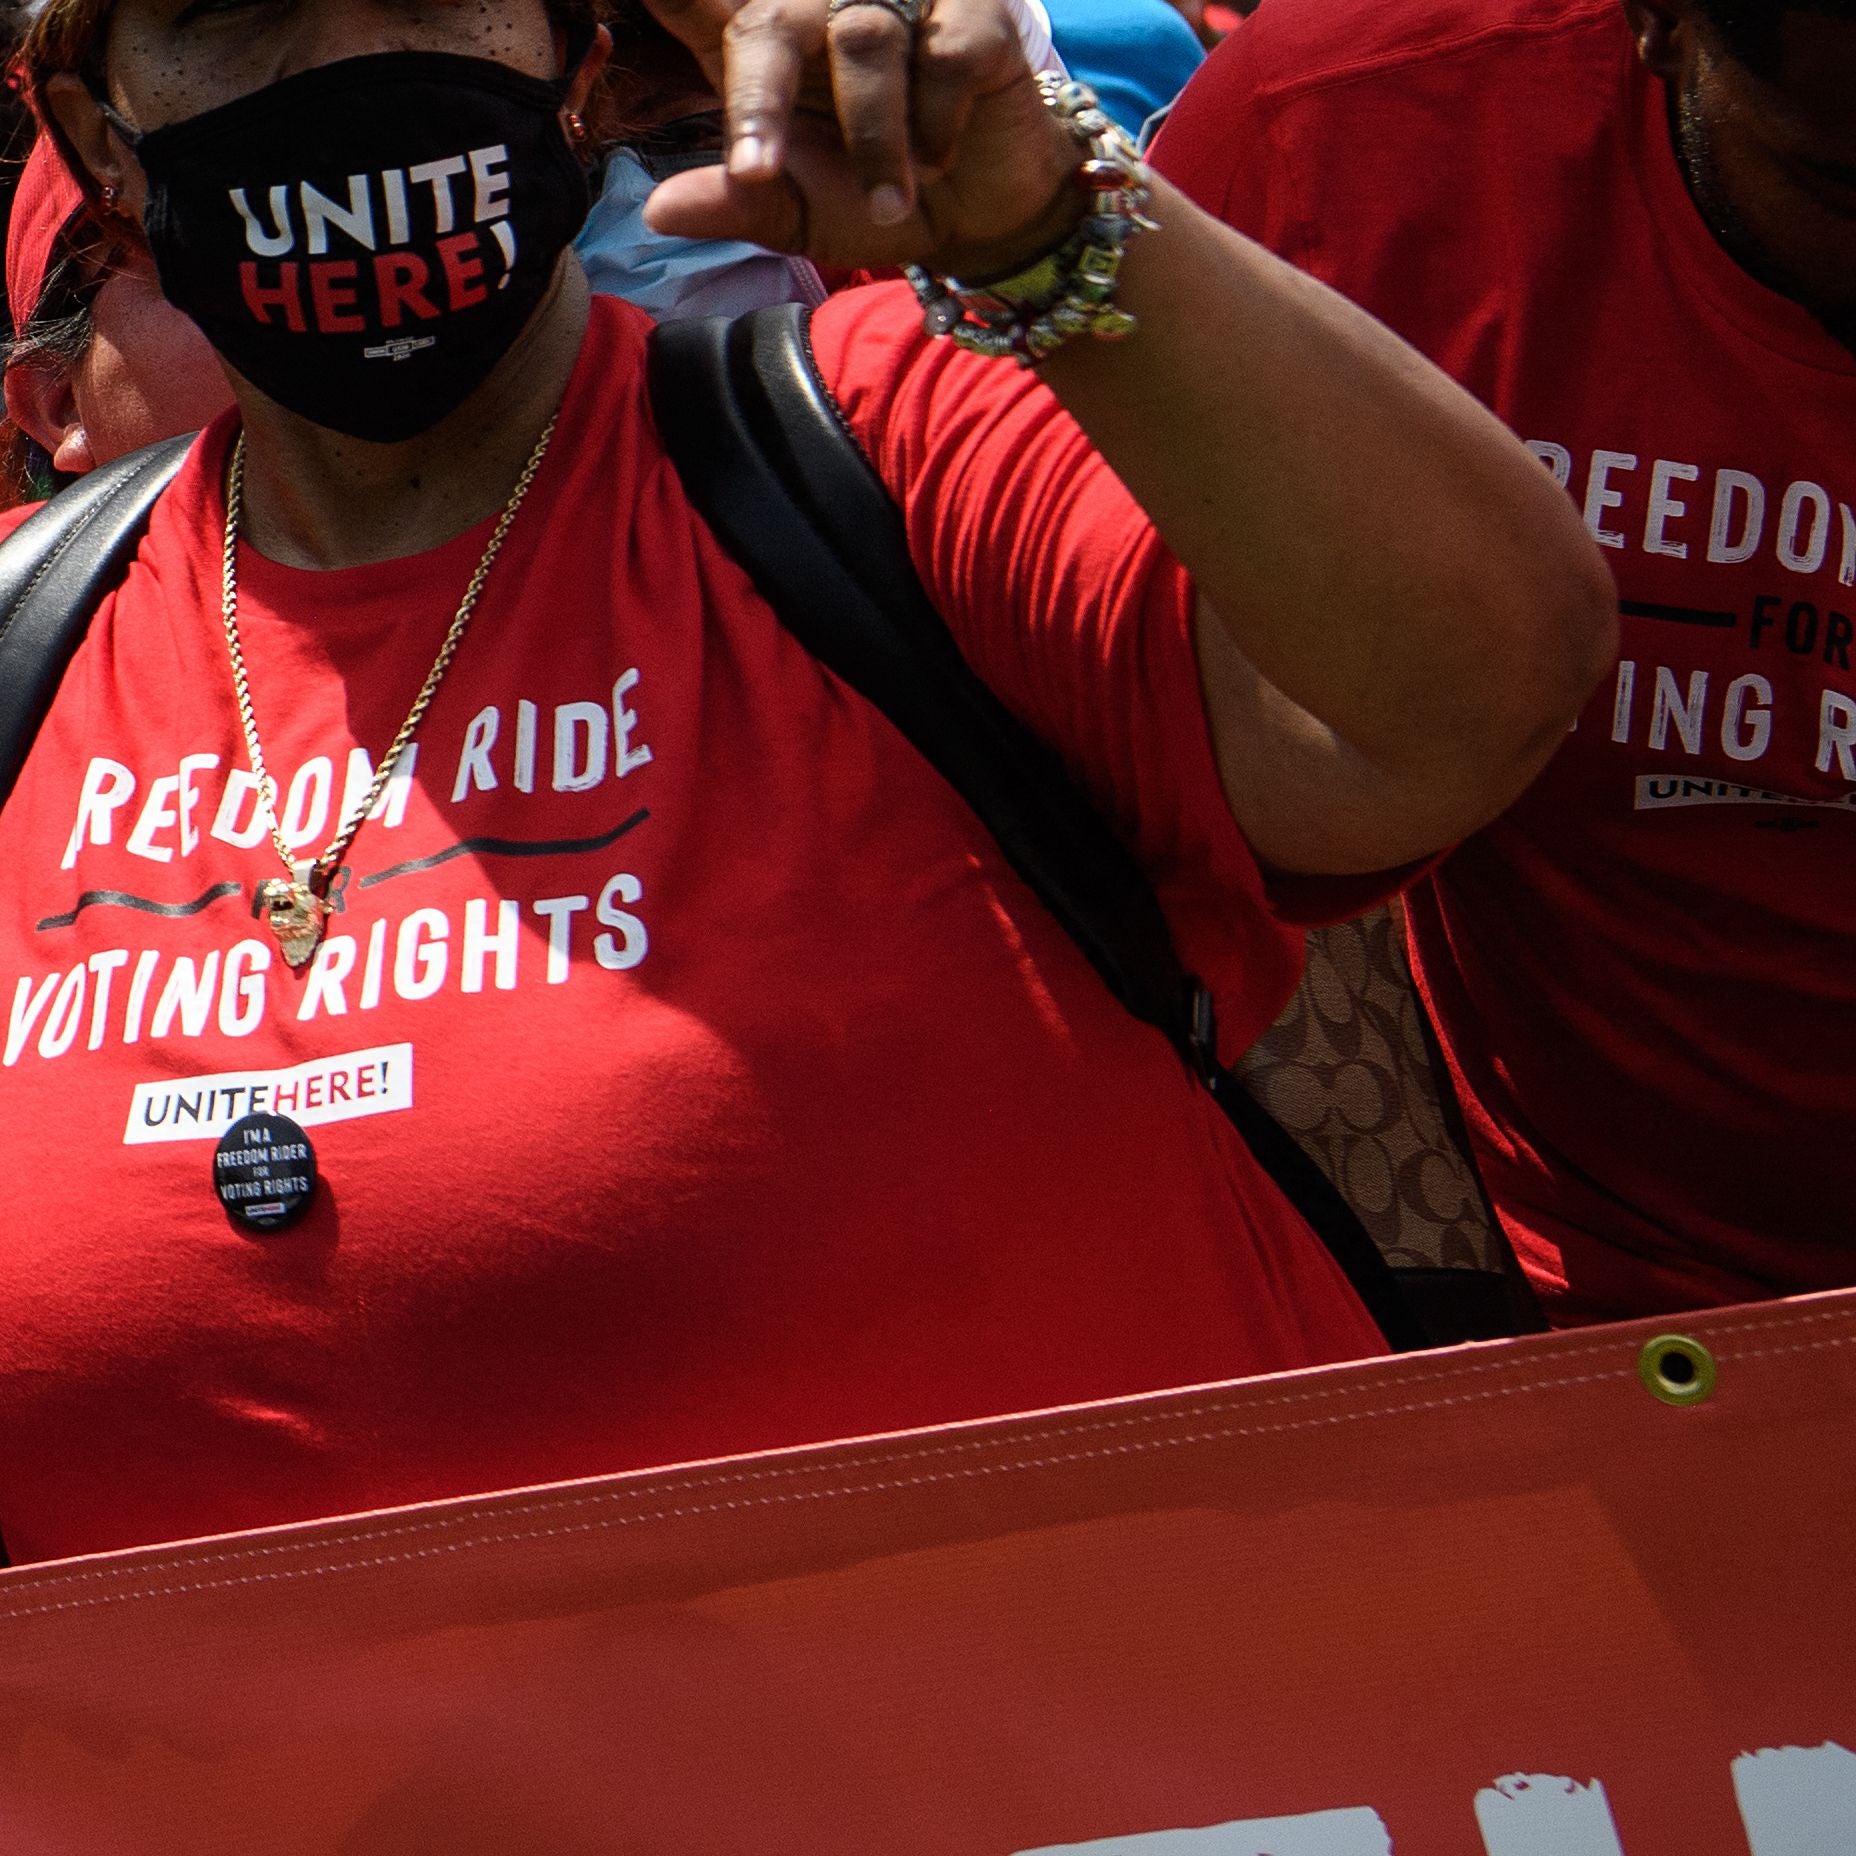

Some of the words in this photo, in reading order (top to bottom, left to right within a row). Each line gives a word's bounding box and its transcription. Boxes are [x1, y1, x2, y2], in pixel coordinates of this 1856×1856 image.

[228, 143, 511, 258] UNITE
[237, 220, 518, 335] HERE!
[1748, 595, 1856, 673] FOR
[60, 742, 419, 871] REEDOM
[452, 667, 653, 804] RIDE
[2, 938, 270, 1066] VOTING
[297, 872, 649, 1022] RIGHTS
[142, 1061, 390, 1130] UNITEHERE!
[216, 1147, 270, 1169] FREEDOM
[270, 1143, 309, 1162] RIDER
[220, 1180, 262, 1201] VOTING
[263, 1175, 309, 1195] RIGHTS
